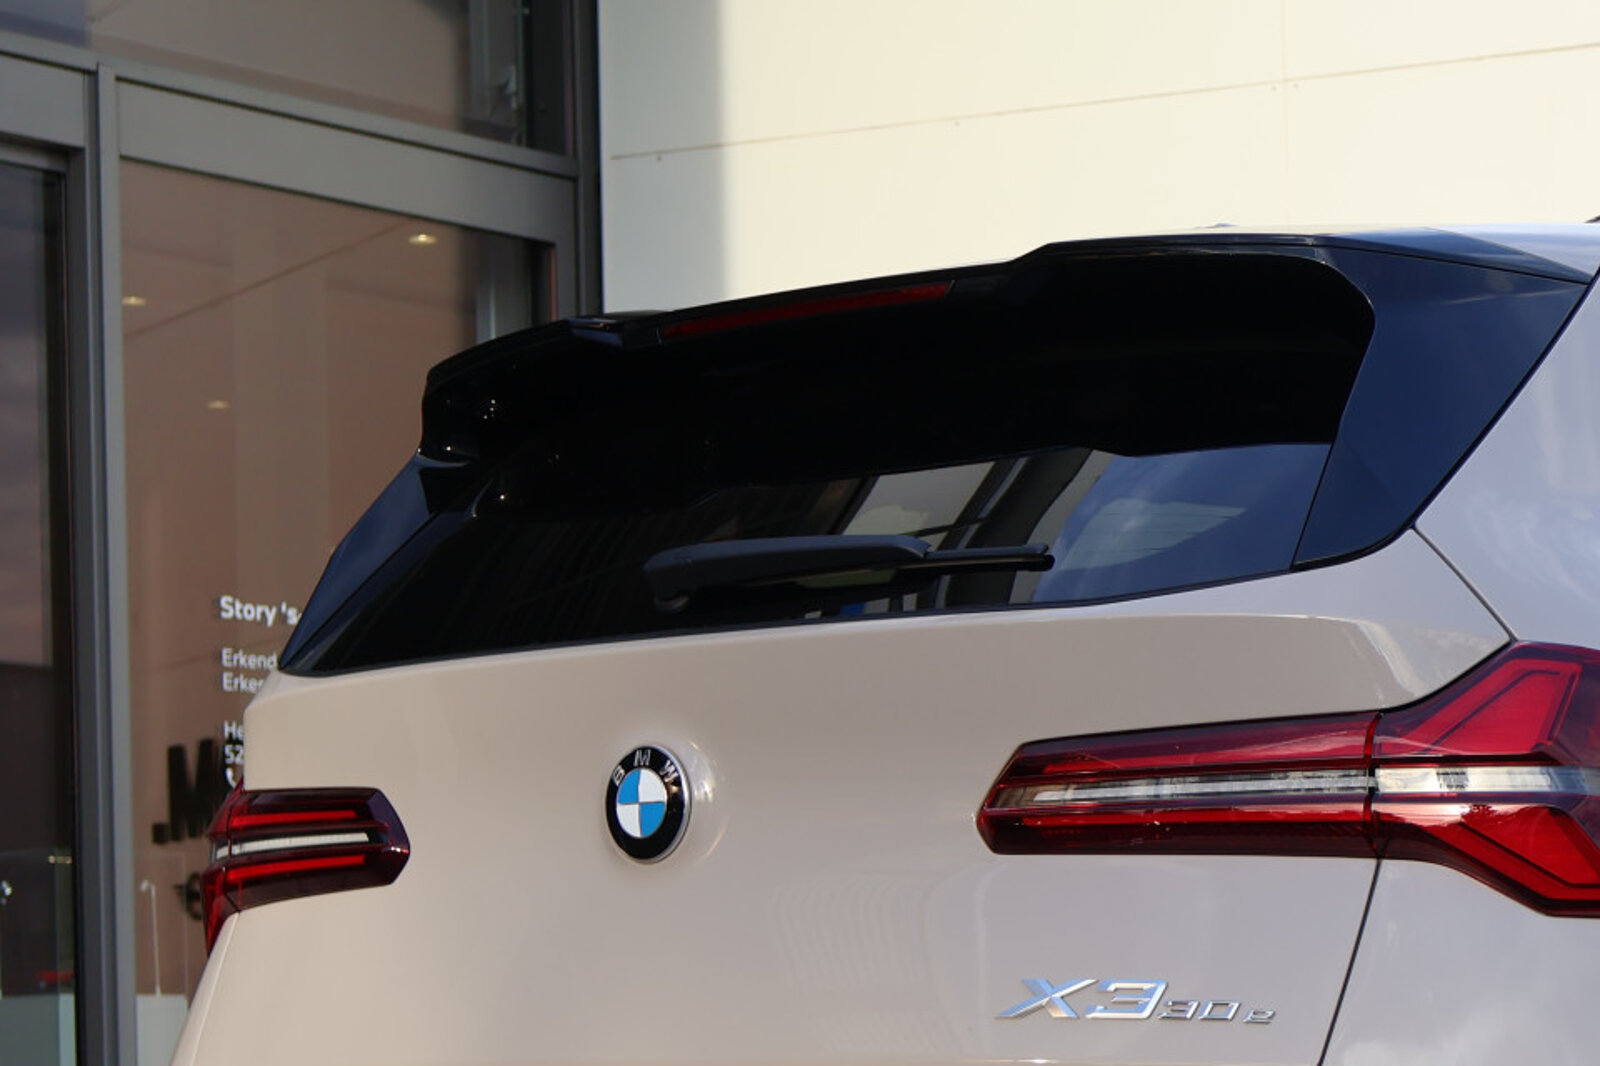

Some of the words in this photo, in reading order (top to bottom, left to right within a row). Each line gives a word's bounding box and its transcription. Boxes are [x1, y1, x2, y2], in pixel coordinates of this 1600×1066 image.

[220, 595, 277, 627] Story
[221, 648, 278, 671] Erkend
[611, 748, 681, 788] BMW
